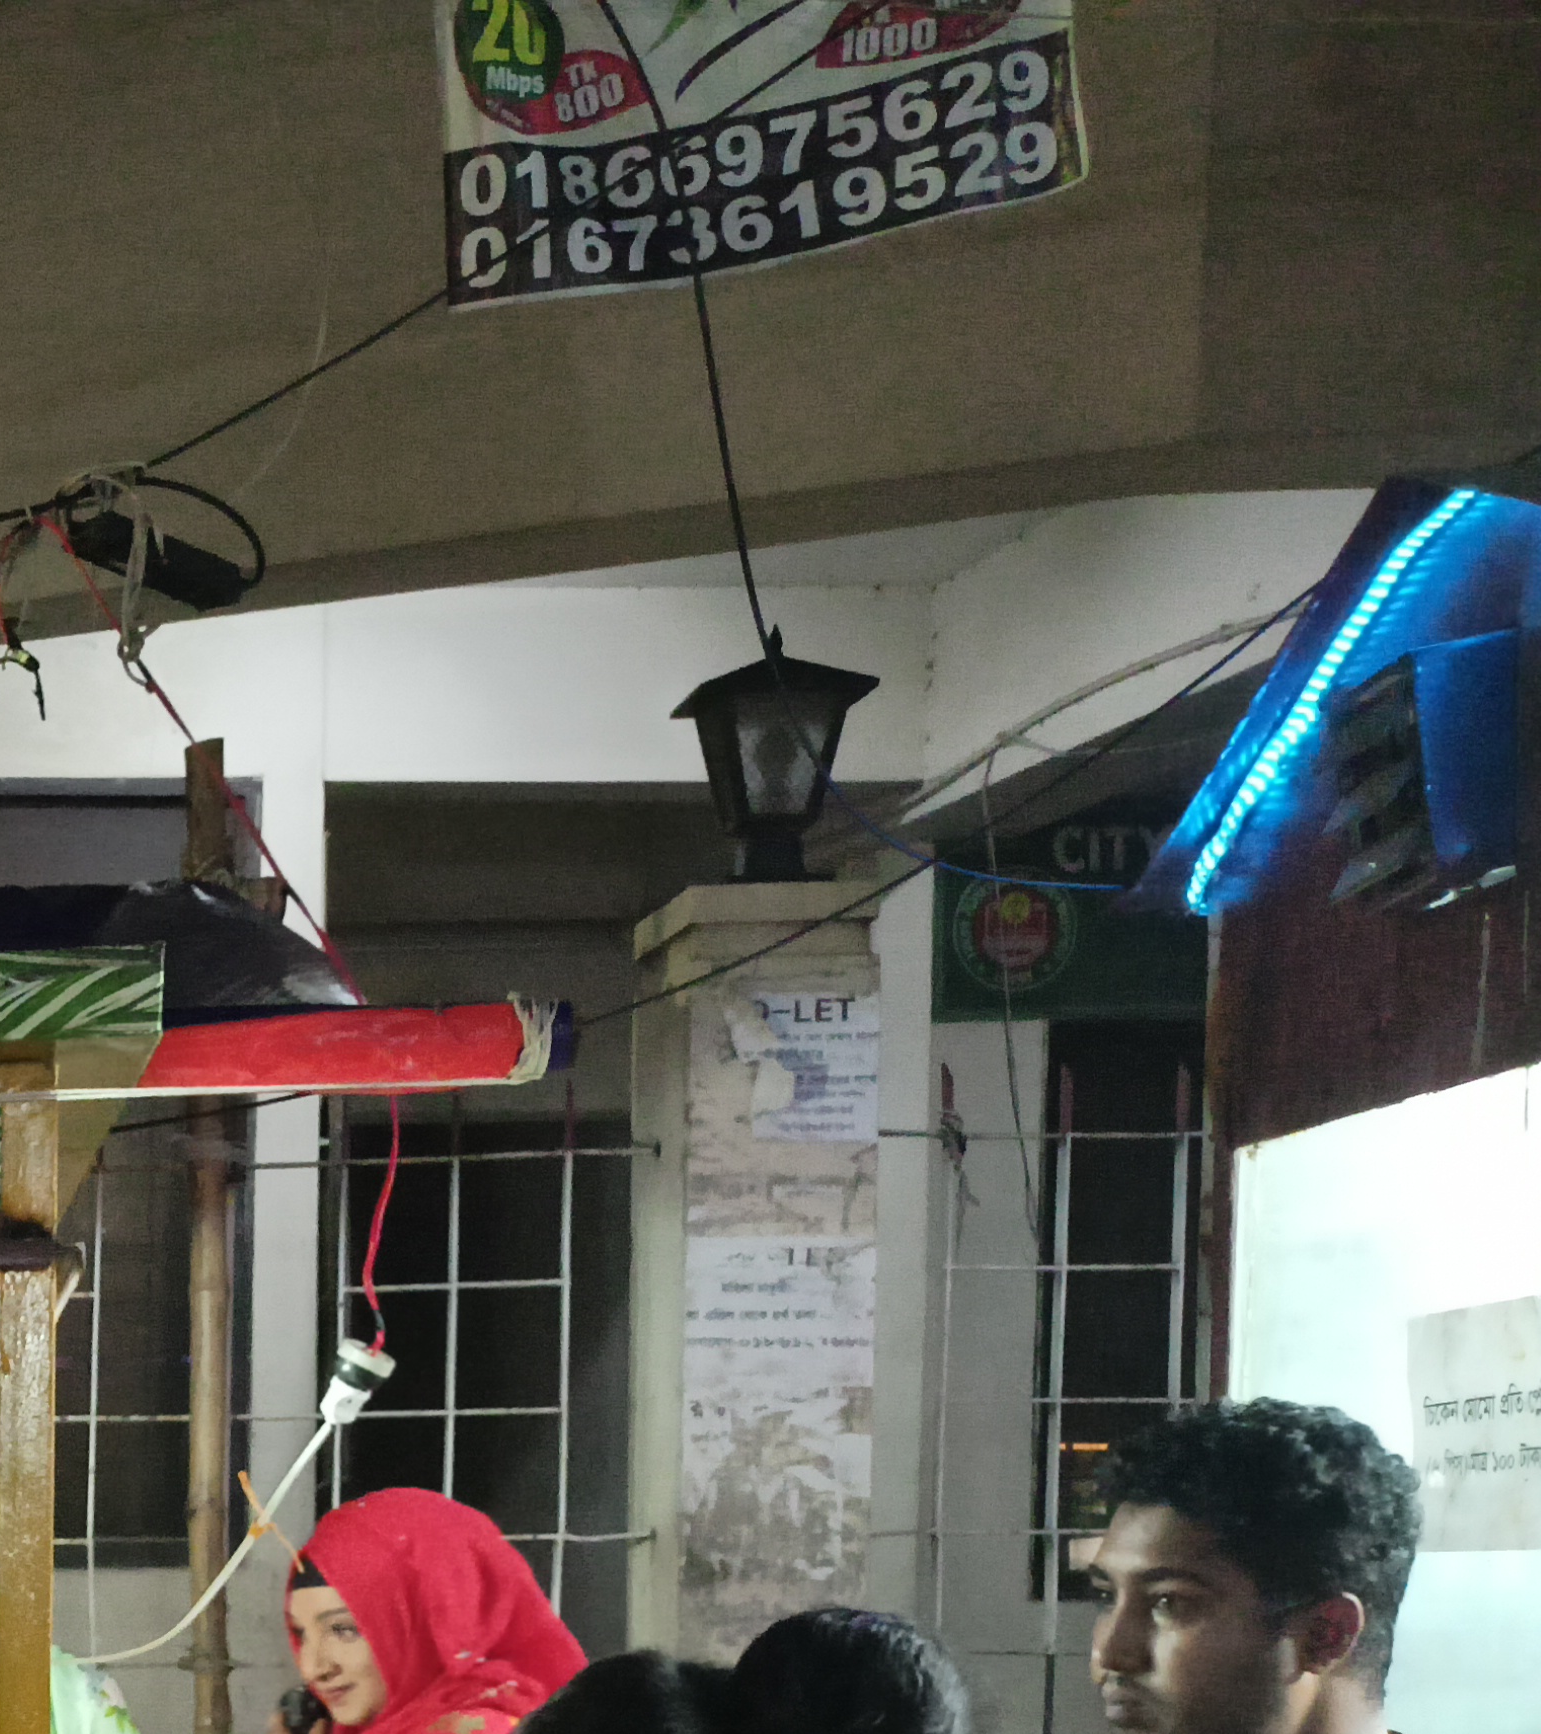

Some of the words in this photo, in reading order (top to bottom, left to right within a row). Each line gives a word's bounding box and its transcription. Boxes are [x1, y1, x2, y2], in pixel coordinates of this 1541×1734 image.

[843, 18, 937, 63] 1000
[485, 66, 545, 98] Mbps
[554, 73, 625, 123] 800
[459, 51, 1050, 216] 01866975629
[459, 120, 1058, 288] 01673619529
[1423, 1395, 1459, 1427] চিকেন
[1492, 1451, 1516, 1473] ১০০
